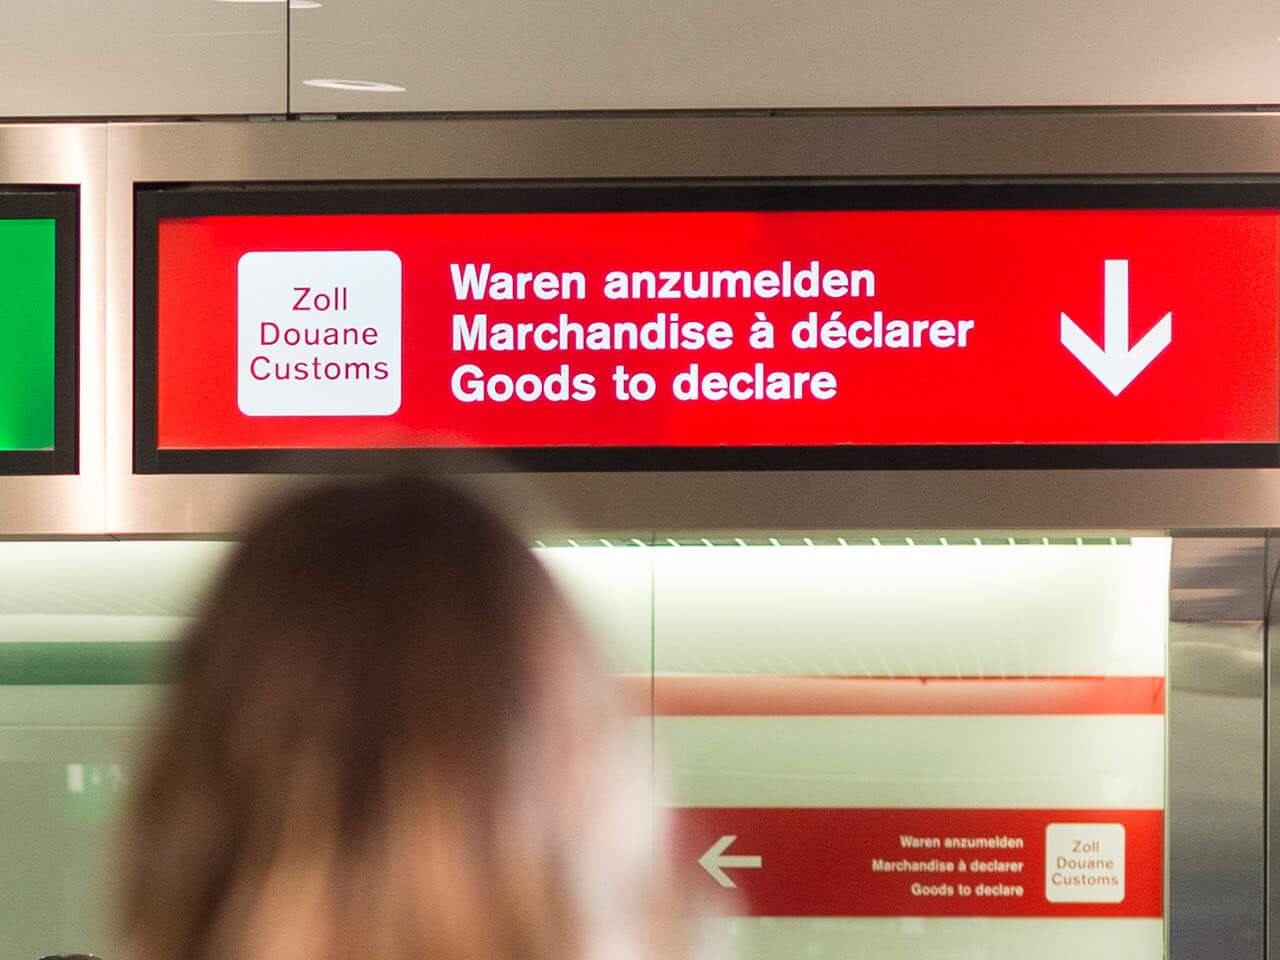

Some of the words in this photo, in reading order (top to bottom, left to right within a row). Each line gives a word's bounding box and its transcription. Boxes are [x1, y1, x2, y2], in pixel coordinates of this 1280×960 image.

[449, 263, 586, 301] Waren
[603, 260, 875, 300] anzumelden
[293, 286, 347, 312] Zoll
[260, 321, 378, 346] Douane
[452, 312, 734, 351] Marchandise
[749, 311, 775, 350] à
[791, 310, 975, 349] déclarer
[250, 355, 389, 382] Customs
[450, 364, 597, 403] Goods
[612, 365, 657, 401] to
[672, 362, 838, 401] declare
[899, 835, 941, 848] Waren
[944, 835, 1024, 848] anzumelden
[1072, 840, 1099, 853] Zoll
[871, 859, 955, 872] Marchandise
[958, 859, 967, 872] à
[1056, 856, 1113, 869] Douane
[1051, 872, 1119, 886] Customs
[911, 882, 955, 896] Goods
[958, 883, 972, 896] to
[975, 883, 1024, 897] declare
